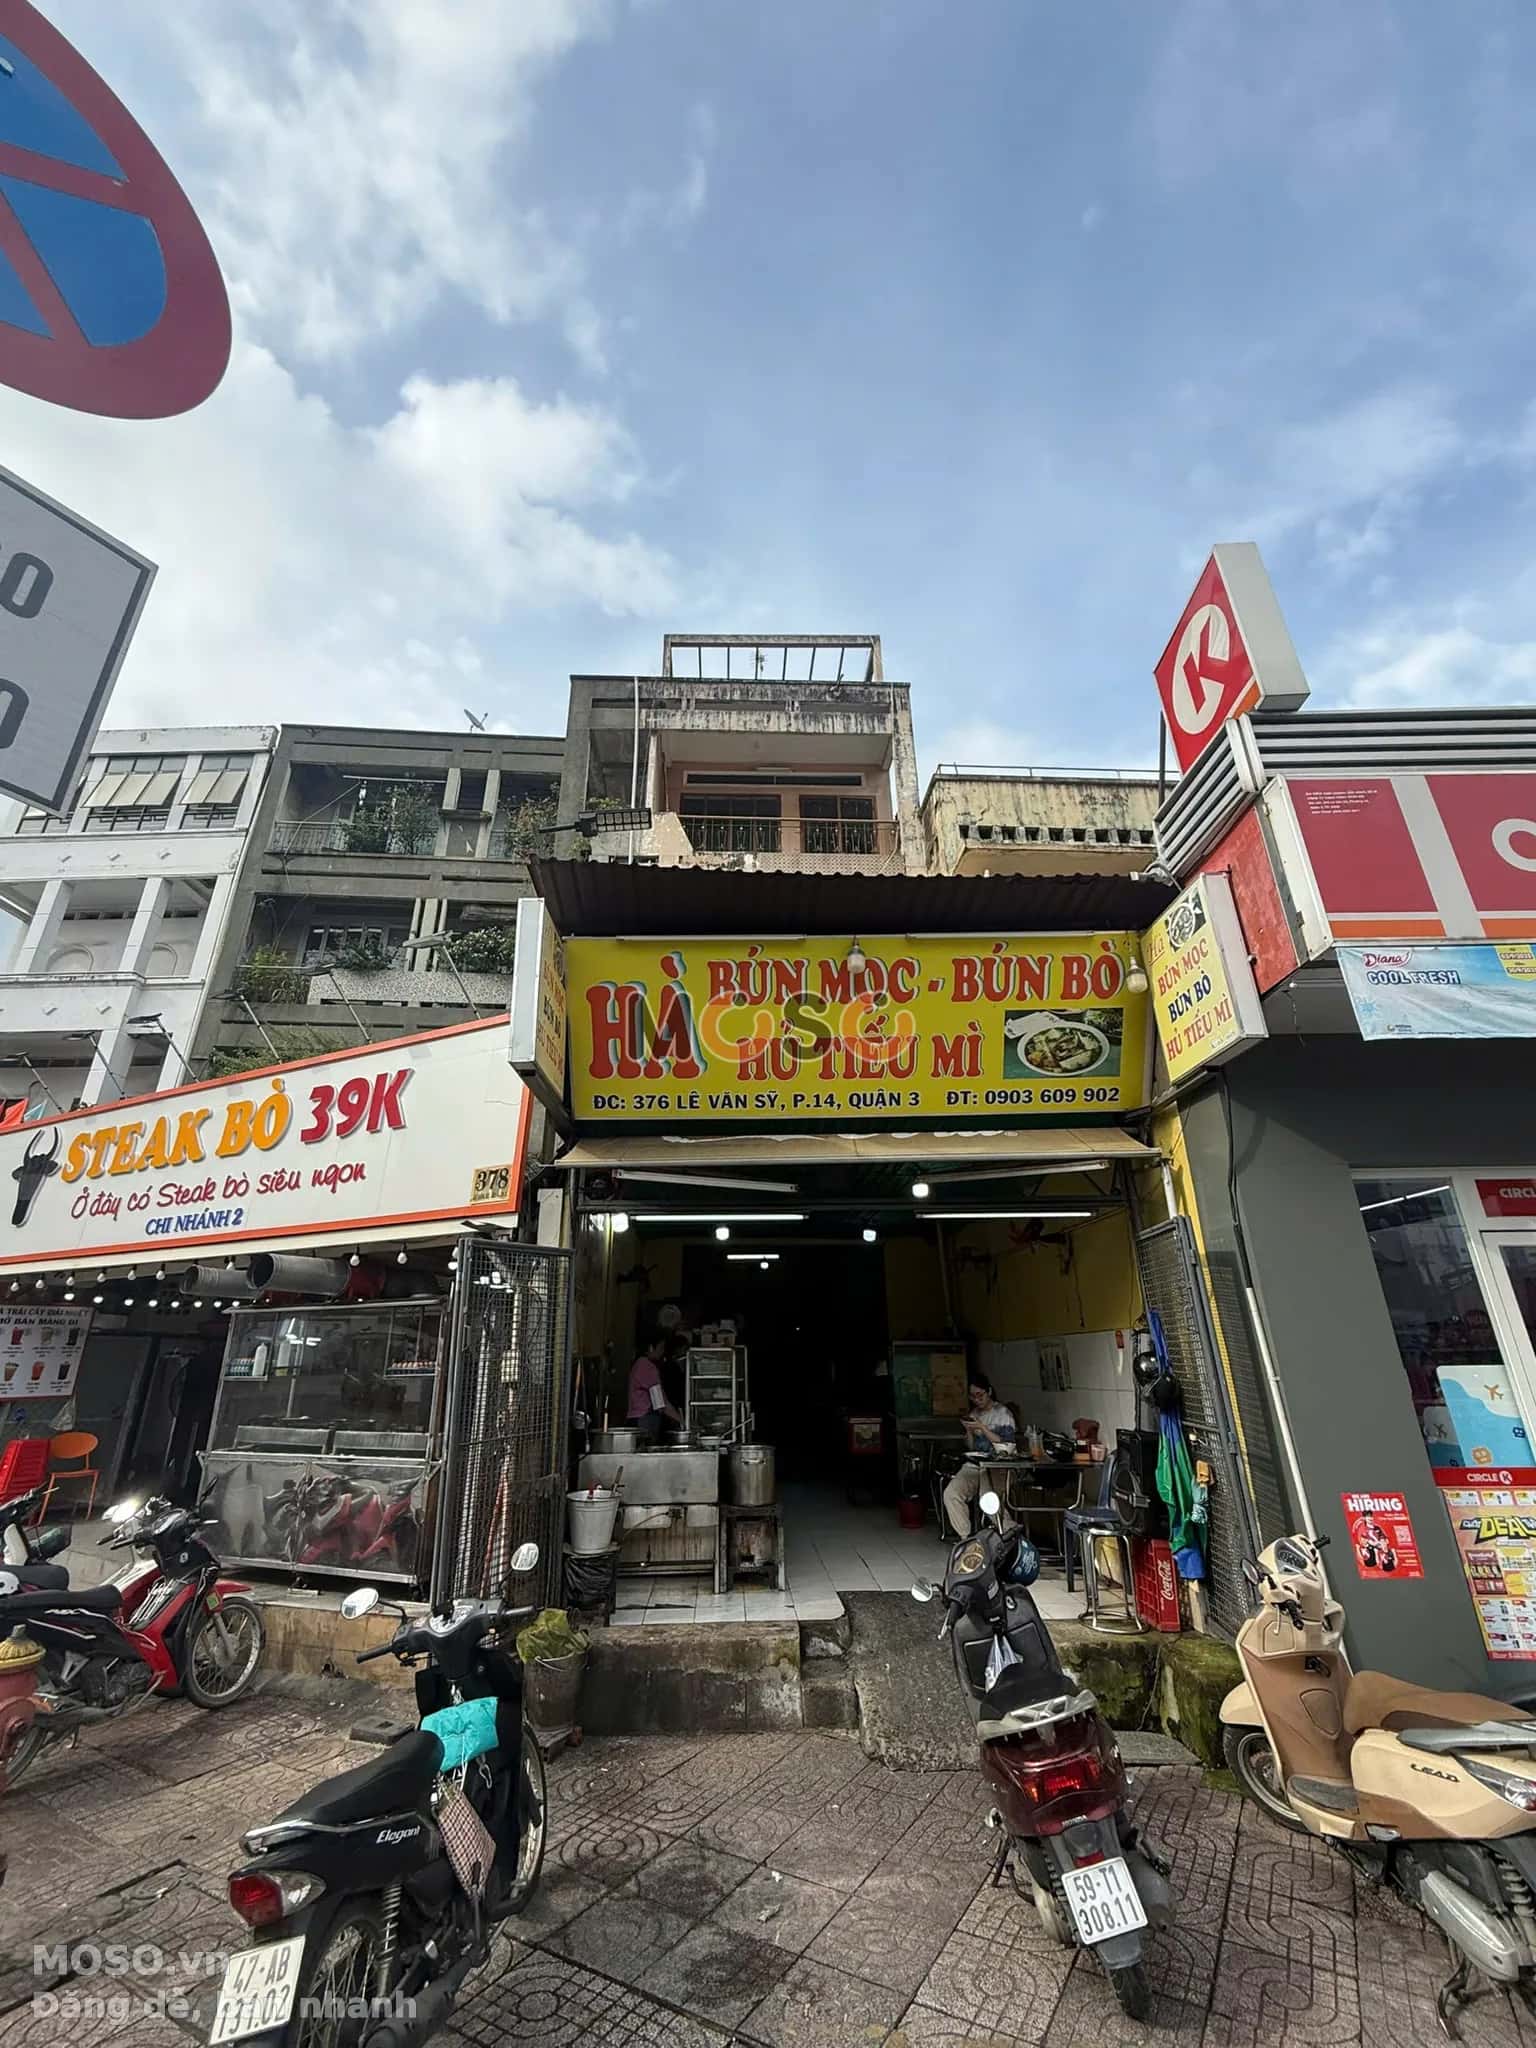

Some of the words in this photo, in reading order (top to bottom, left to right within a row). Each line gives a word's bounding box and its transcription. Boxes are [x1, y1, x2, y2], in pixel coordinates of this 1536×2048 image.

[707, 945, 805, 1006] BÚN
[952, 941, 1053, 1002] BÚN
[1061, 940, 1122, 1000] BÒ
[1157, 965, 1182, 997] BÚN
[1182, 938, 1209, 975] MỌC
[1363, 952, 1410, 968] Diana
[1367, 970, 1410, 985] COOL
[1410, 970, 1461, 985] FRESH
[1168, 988, 1193, 1023] BÚN
[1195, 970, 1212, 1002] BÒ
[1214, 993, 1233, 1027] MÌ
[585, 952, 705, 1079] HÀ
[931, 1020, 985, 1078] MÌ
[593, 1095, 626, 1110] ĐC:
[633, 1095, 670, 1110] 376
[677, 1091, 700, 1109] LÊ
[793, 1093, 842, 1110] P.14,
[848, 1089, 901, 1110] QUẬN
[908, 1092, 920, 1106] 3
[946, 1091, 978, 1105] ĐT:
[985, 1090, 1033, 1105] 0903
[1040, 1088, 1077, 1104] 609
[1083, 1087, 1120, 1102] 902
[61, 1108, 212, 1183] STEAK
[215, 1078, 292, 1158] BÒ
[301, 1068, 414, 1144] 39K
[71, 1186, 90, 1219] Ở
[89, 1190, 123, 1221] đây
[127, 1185, 154, 1212] có
[157, 1176, 217, 1207] Steak
[222, 1171, 250, 1200] bò
[256, 1168, 302, 1194] siêu
[311, 1162, 367, 1194] ngon
[475, 1168, 509, 1191] 378
[145, 1217, 172, 1236] CHI
[174, 1207, 232, 1233] NHÁNH
[231, 1207, 244, 1226] 2
[1467, 1473, 1499, 1482] CIRCLE
[1347, 1498, 1402, 1512] HIRING
[376, 1825, 420, 1844] Elegant
[1079, 1893, 1139, 1936] 308.11
